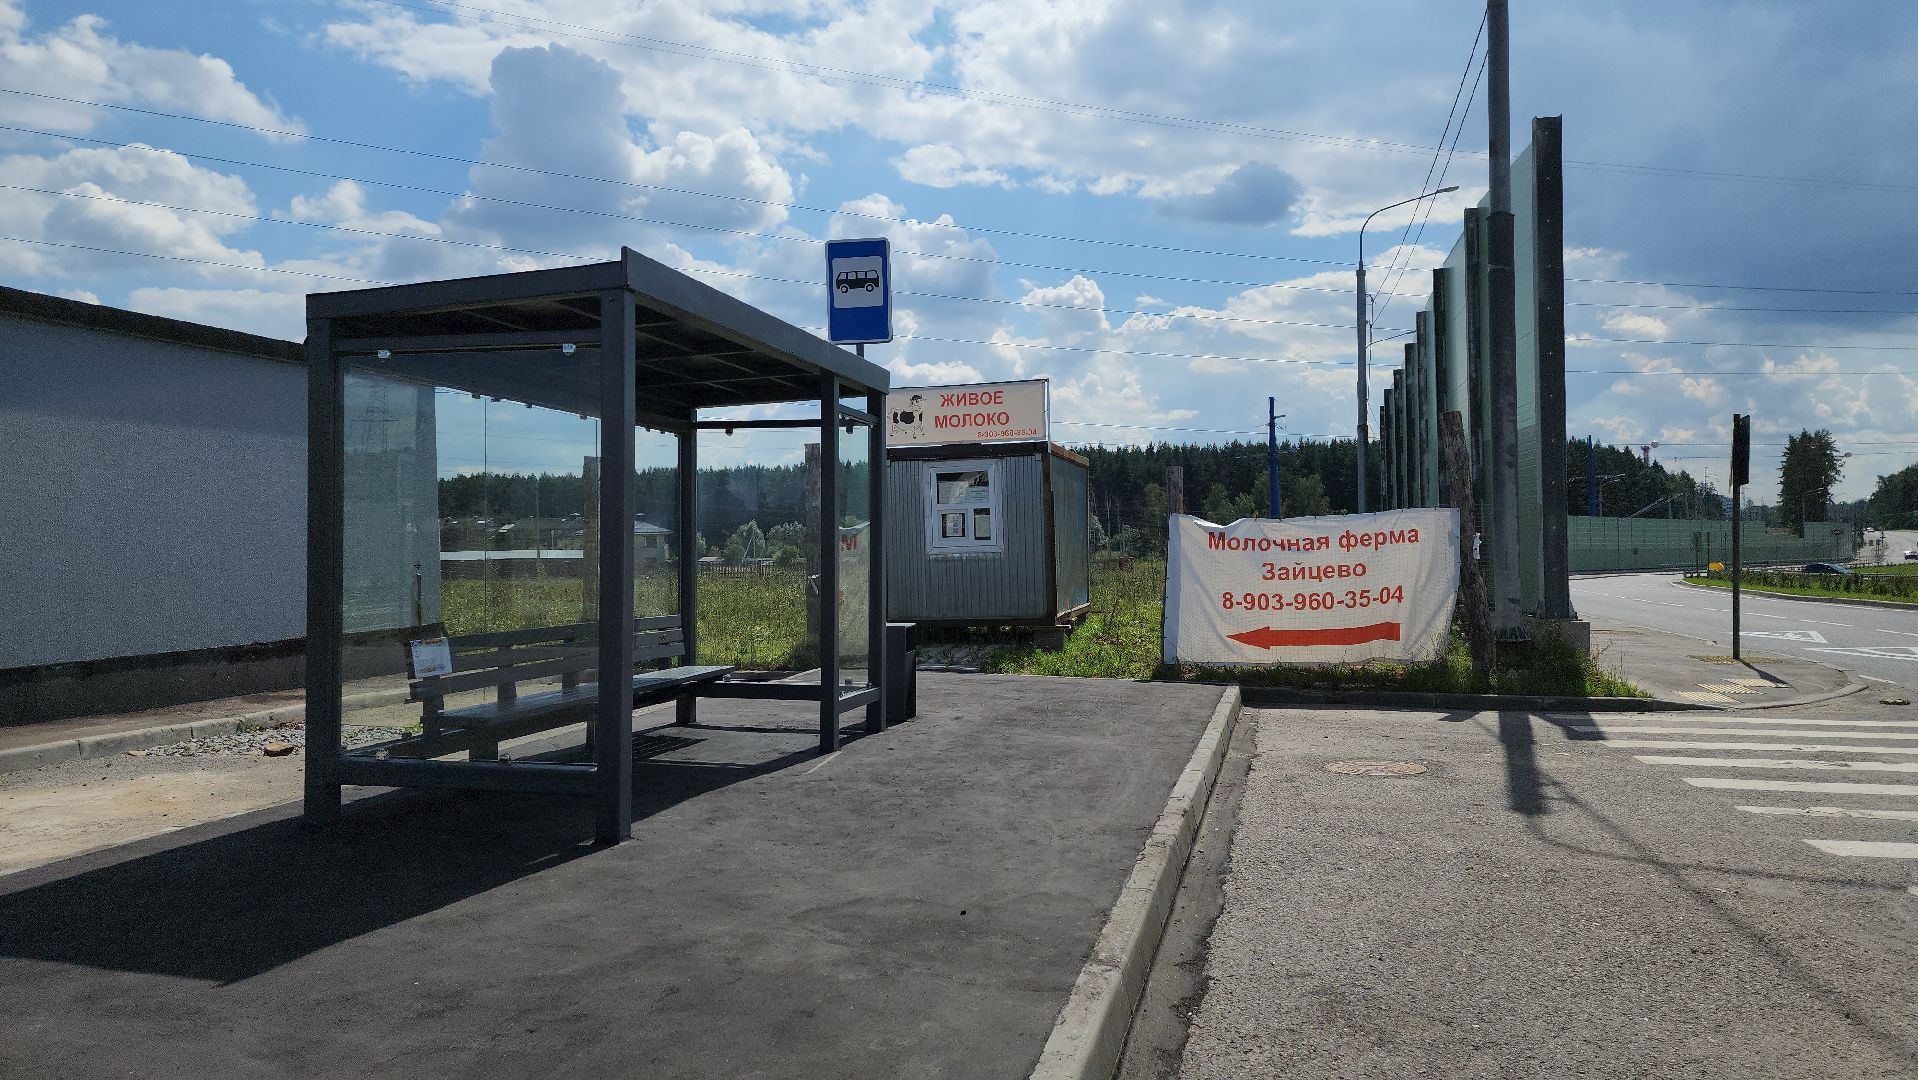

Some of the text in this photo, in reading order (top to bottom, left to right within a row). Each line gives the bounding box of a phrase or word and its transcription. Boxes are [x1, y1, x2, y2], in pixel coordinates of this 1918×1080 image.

[940, 390, 1004, 408] ЖИВОЕ
[934, 411, 1010, 429] МОЛОКО
[1208, 528, 1420, 553] Молочная ферма
[1262, 561, 1368, 583] Зайцево
[1221, 585, 1405, 611] 8-903-960-35-04
